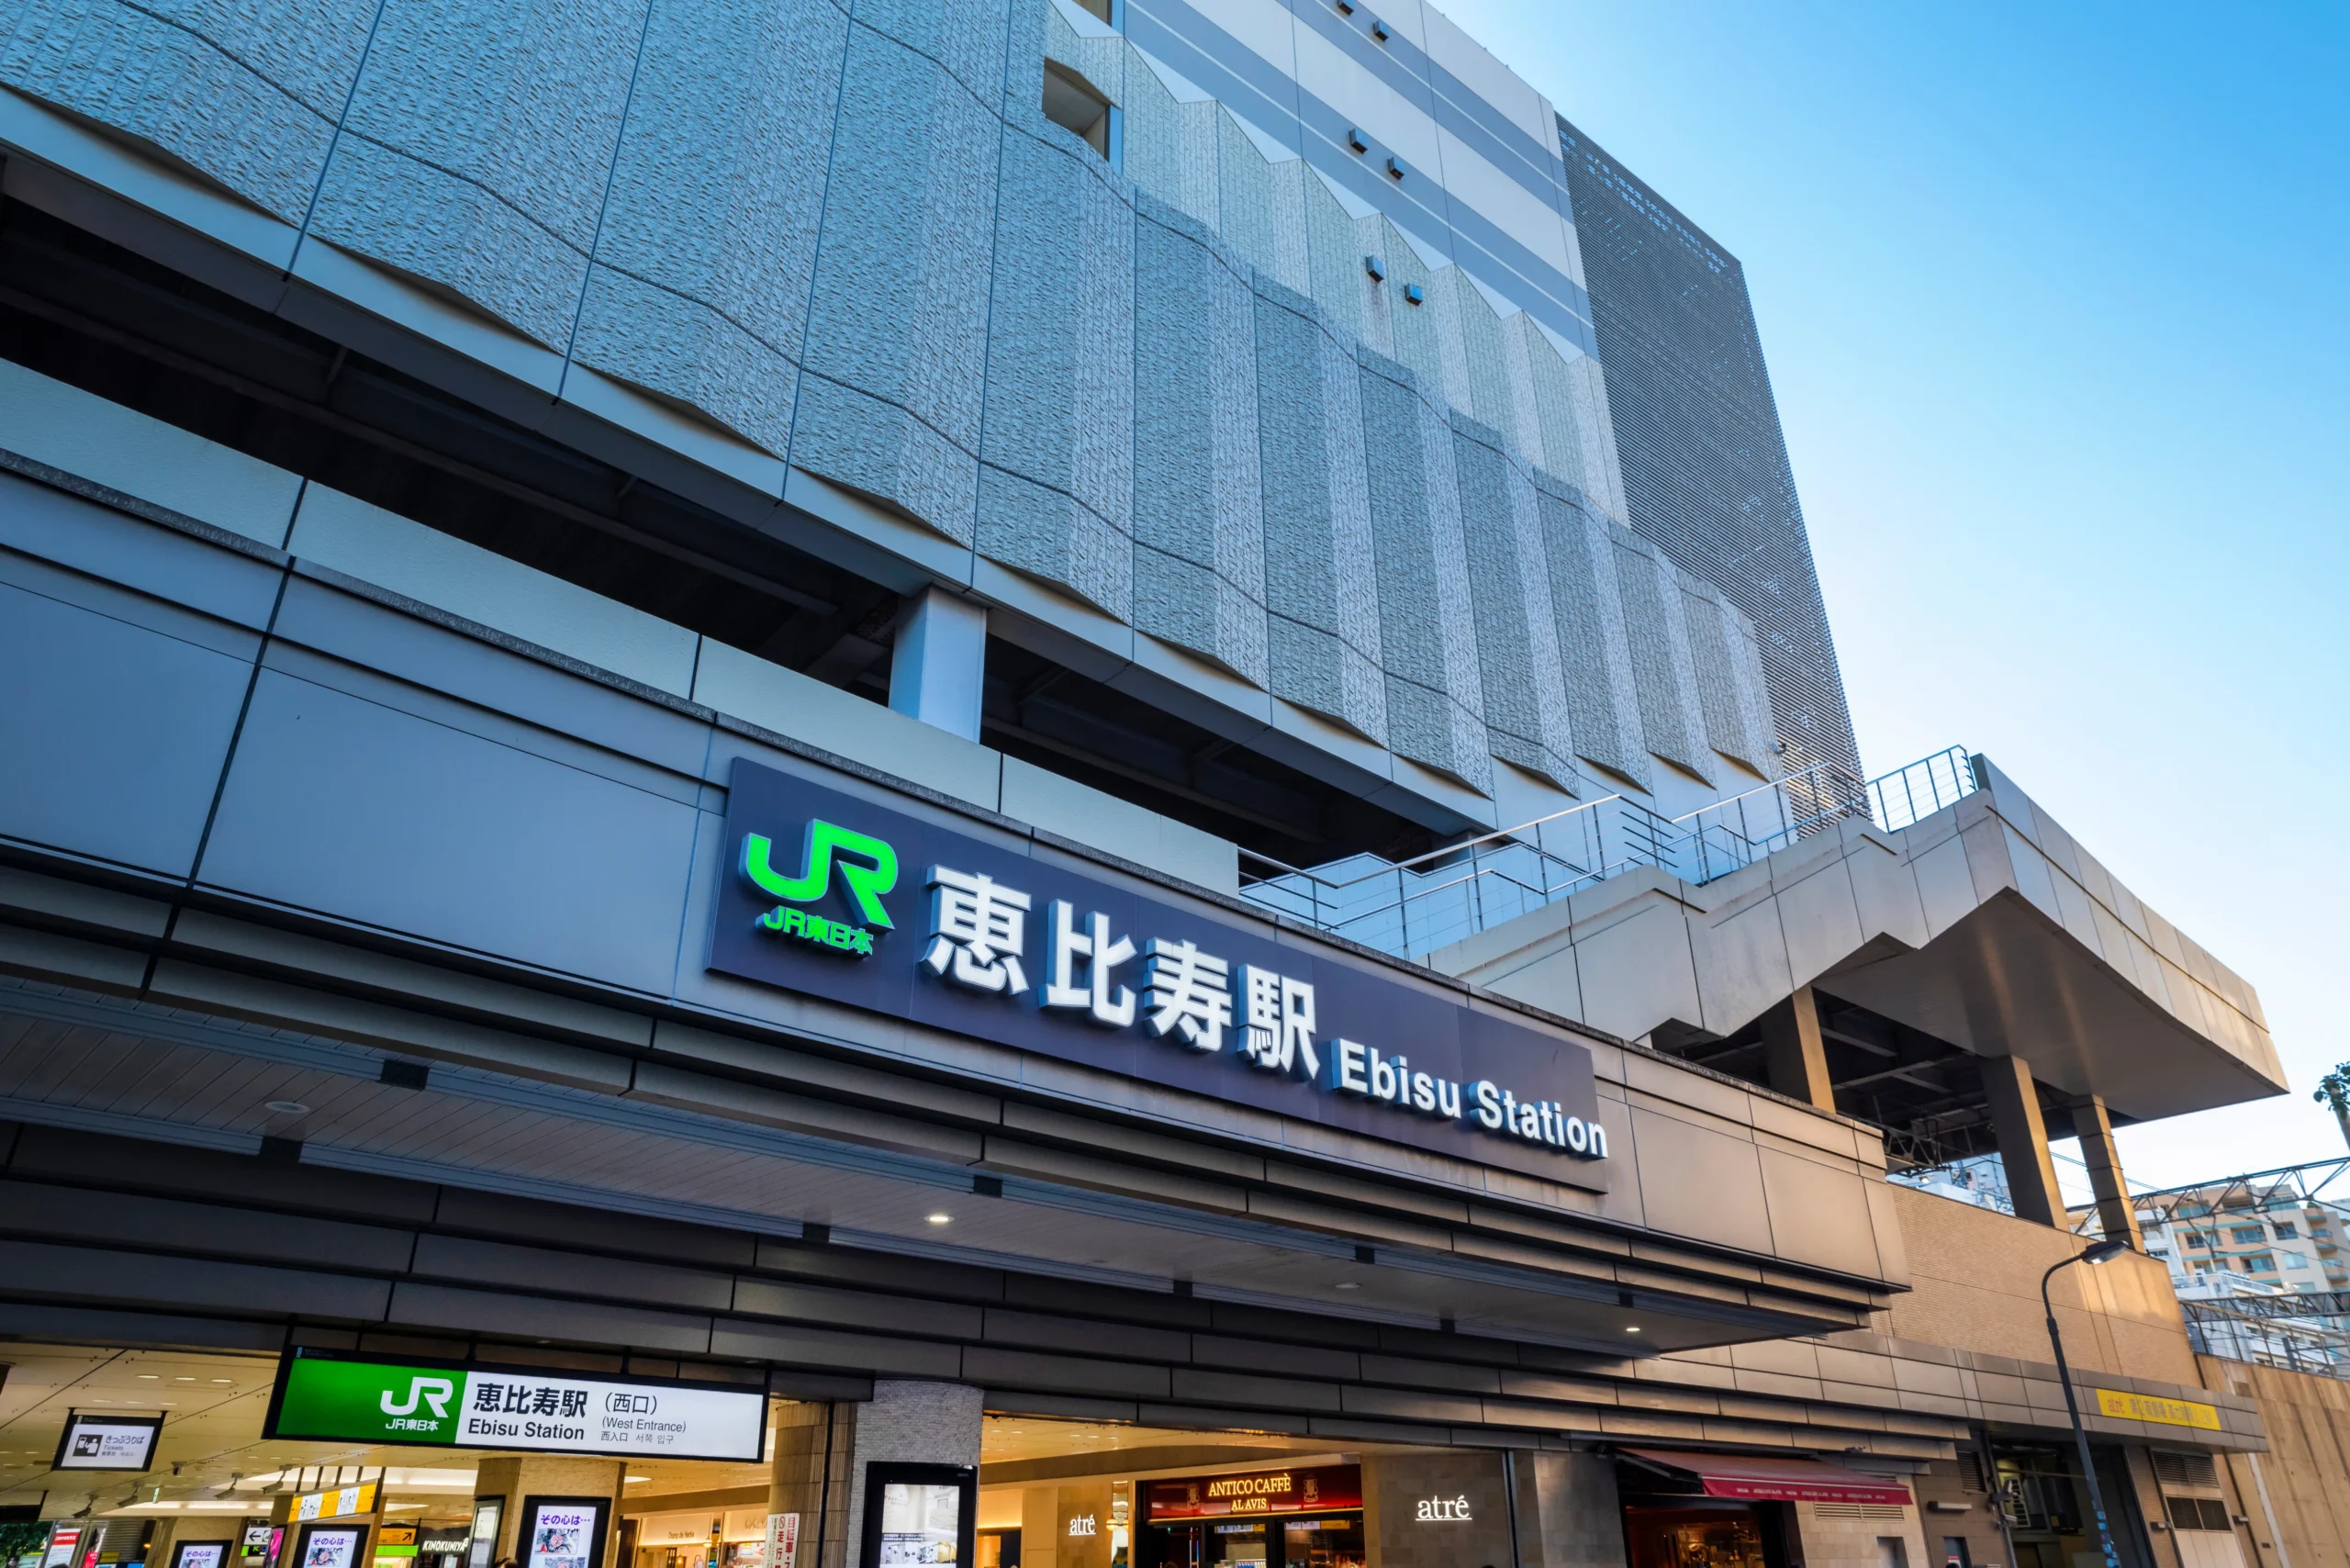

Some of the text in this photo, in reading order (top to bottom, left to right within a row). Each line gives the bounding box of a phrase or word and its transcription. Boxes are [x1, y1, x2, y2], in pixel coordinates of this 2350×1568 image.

[740, 818, 899, 933] JR
[758, 905, 873, 958] JR東日本
[921, 864, 1608, 1159] 恵比寿駅 Ebisu Station
[380, 1376, 453, 1418] JR
[473, 1383, 588, 1418] 恵比寿駅
[386, 1418, 439, 1431] JR東日本
[468, 1418, 585, 1439] Ebisu Station
[602, 1416, 687, 1434] (West Entrance)
[601, 1431, 628, 1442] 西入口
[1208, 1473, 1292, 1496] ANTICO CAFFÈ
[1231, 1498, 1267, 1511] AL AVIS
[1416, 1495, 1472, 1521] atré
[1069, 1514, 1096, 1536] atré
